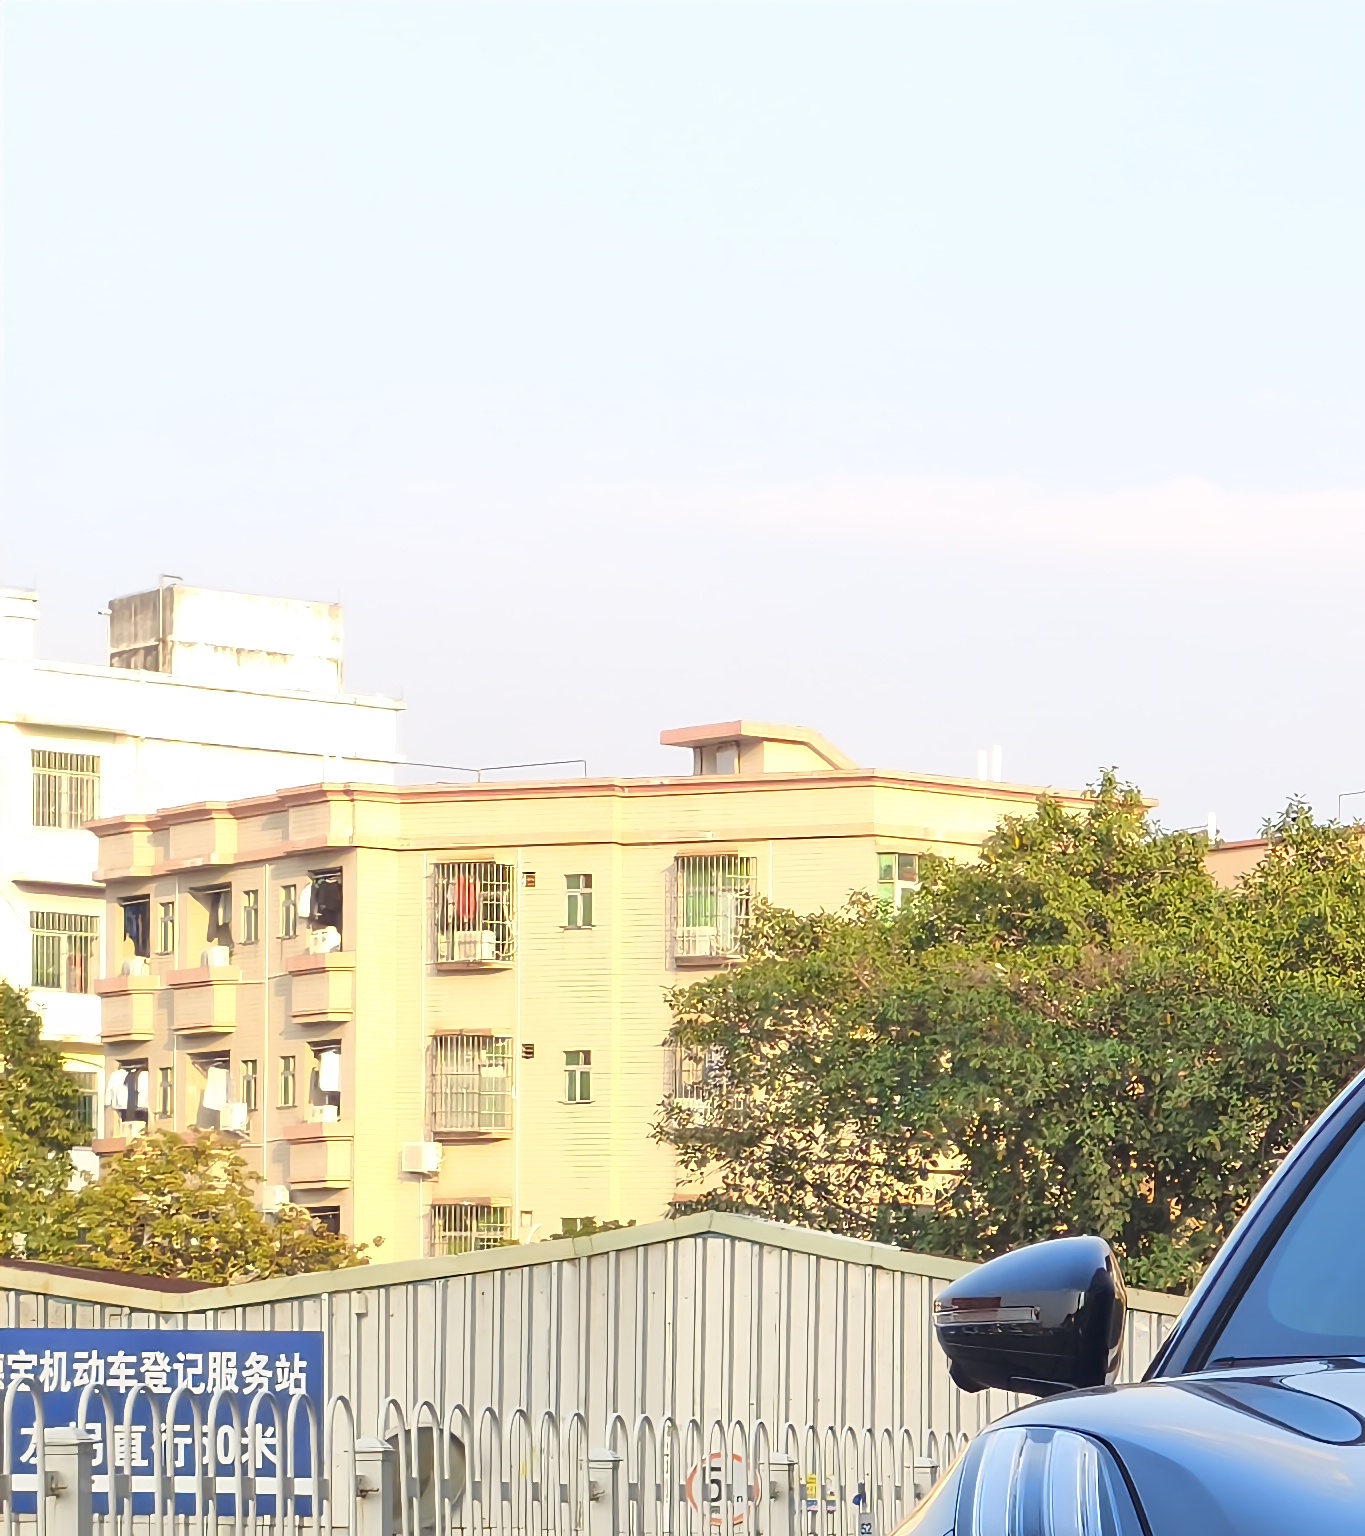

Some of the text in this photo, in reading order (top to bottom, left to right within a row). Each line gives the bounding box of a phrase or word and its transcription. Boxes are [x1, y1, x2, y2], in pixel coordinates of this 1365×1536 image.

[0, 1349, 308, 1395] 宝机动车登记服务站
